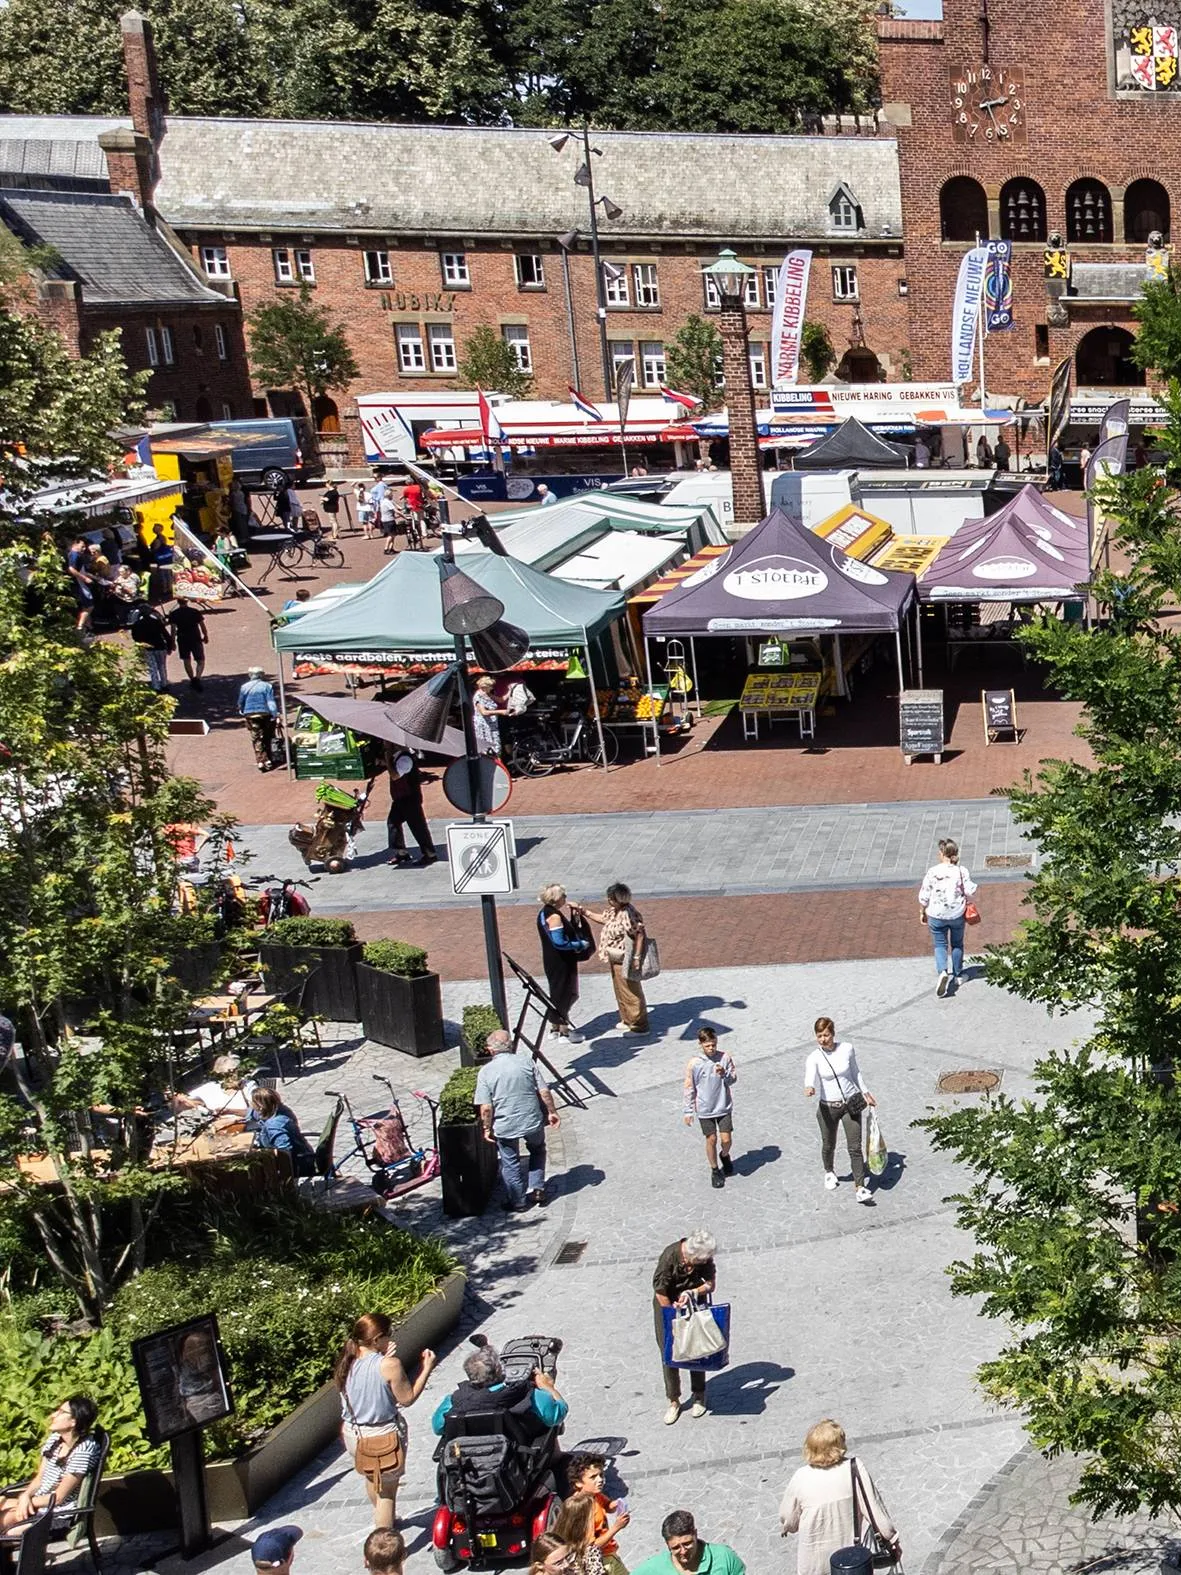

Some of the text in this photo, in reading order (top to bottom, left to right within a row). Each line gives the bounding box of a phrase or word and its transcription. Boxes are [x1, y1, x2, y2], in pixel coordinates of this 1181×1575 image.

[968, 73, 976, 83] 11
[981, 68, 991, 80] 12
[999, 73, 1003, 84] 1
[957, 82, 967, 94] 10
[1009, 84, 1016, 95] 2
[955, 98, 963, 108] 9
[1013, 99, 1020, 110] 3
[960, 112, 968, 123] 8
[1009, 114, 1018, 124] 4
[971, 124, 978, 134] 7
[985, 128, 993, 138] 6
[999, 124, 1008, 135] 5
[987, 242, 1008, 254] GO
[965, 255, 984, 305] NIEUWE
[381, 293, 457, 312] NUBIKK
[777, 257, 805, 380] WARME KIBBELING
[991, 313, 1010, 325] GO
[773, 393, 813, 403] KIBBELING
[832, 390, 955, 401] NIEUWE HARING GEBAKKEN VIS
[583, 478, 601, 487] VIS
